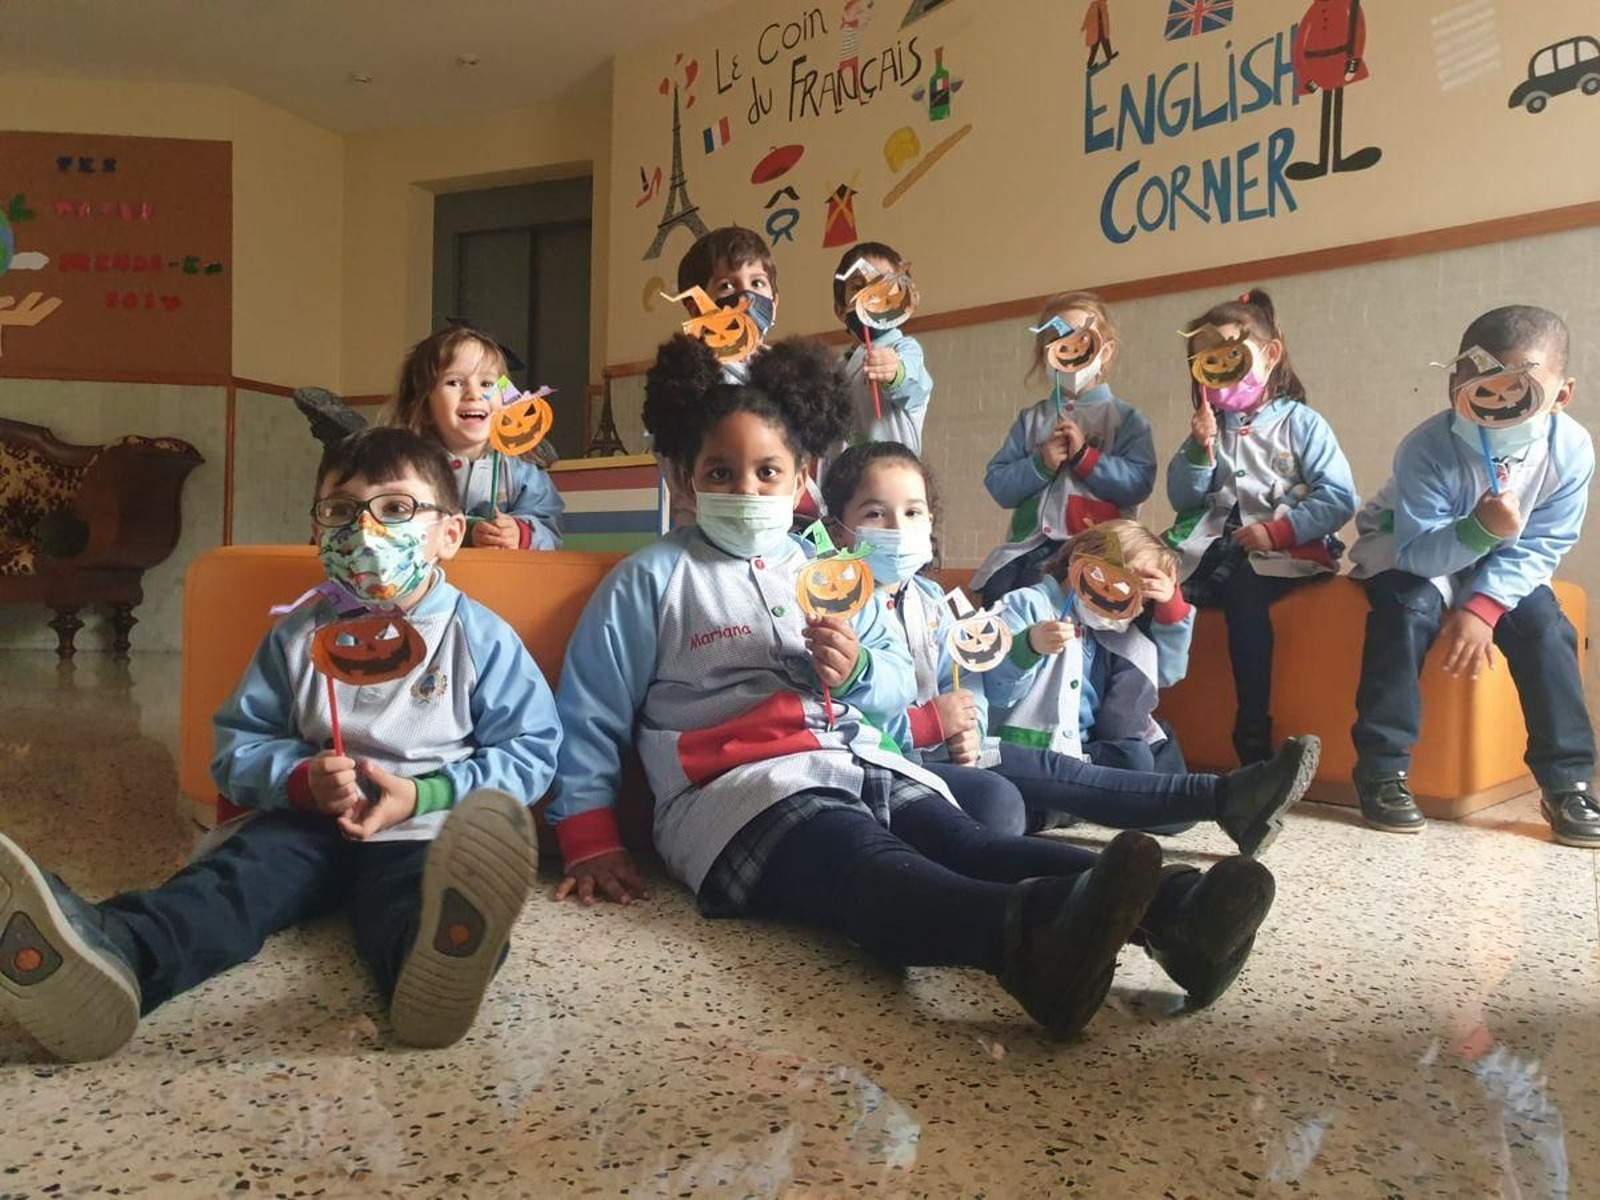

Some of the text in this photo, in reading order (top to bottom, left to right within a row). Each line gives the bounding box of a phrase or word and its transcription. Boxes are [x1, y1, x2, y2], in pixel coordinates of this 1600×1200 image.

[747, 77, 774, 125] du
[1101, 127, 1298, 243] CORNER
[690, 624, 752, 651] Mariana
